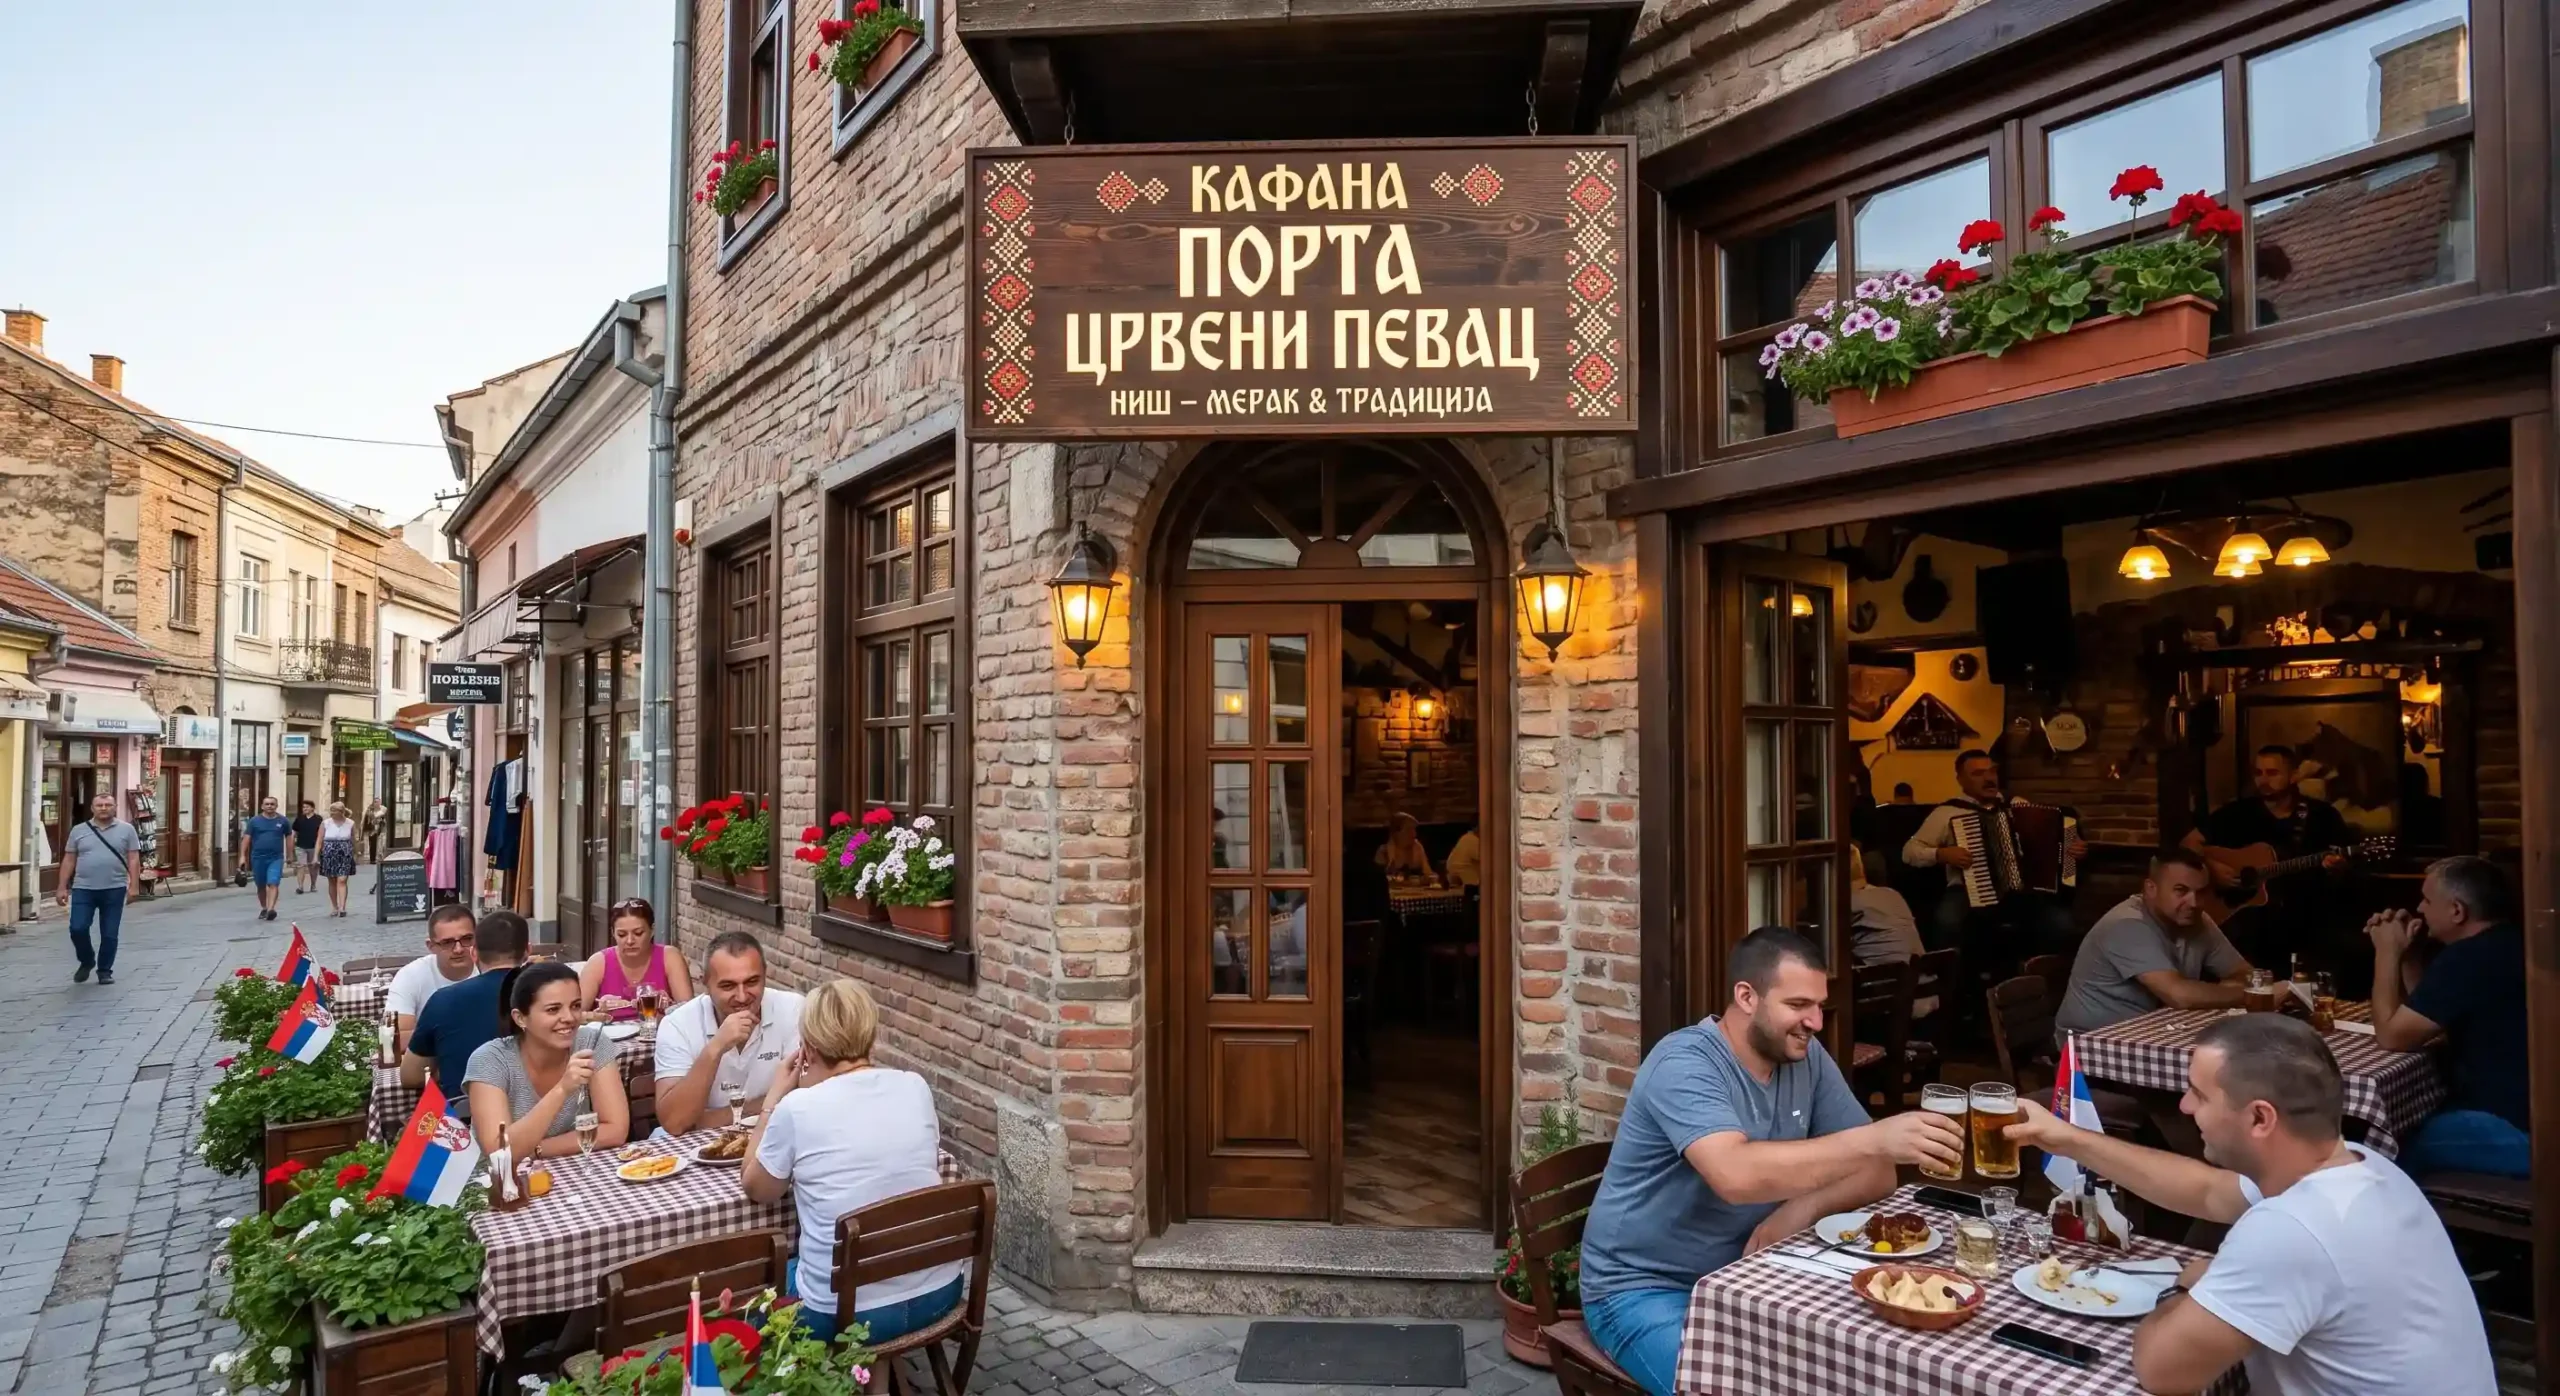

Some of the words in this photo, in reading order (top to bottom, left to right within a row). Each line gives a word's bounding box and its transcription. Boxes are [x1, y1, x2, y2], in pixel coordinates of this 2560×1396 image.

[1191, 163, 1409, 213] КАФАНА
[1179, 223, 1423, 298] ПОРТА
[1066, 309, 1308, 386] ЦРВЕНИ
[1333, 307, 1540, 382] ПЕВАЦ
[1110, 389, 1171, 416] НИШ
[1206, 387, 1300, 415] МЕРАК
[1308, 387, 1327, 414] &
[1335, 386, 1494, 419] ТРАДИЦИЈА
